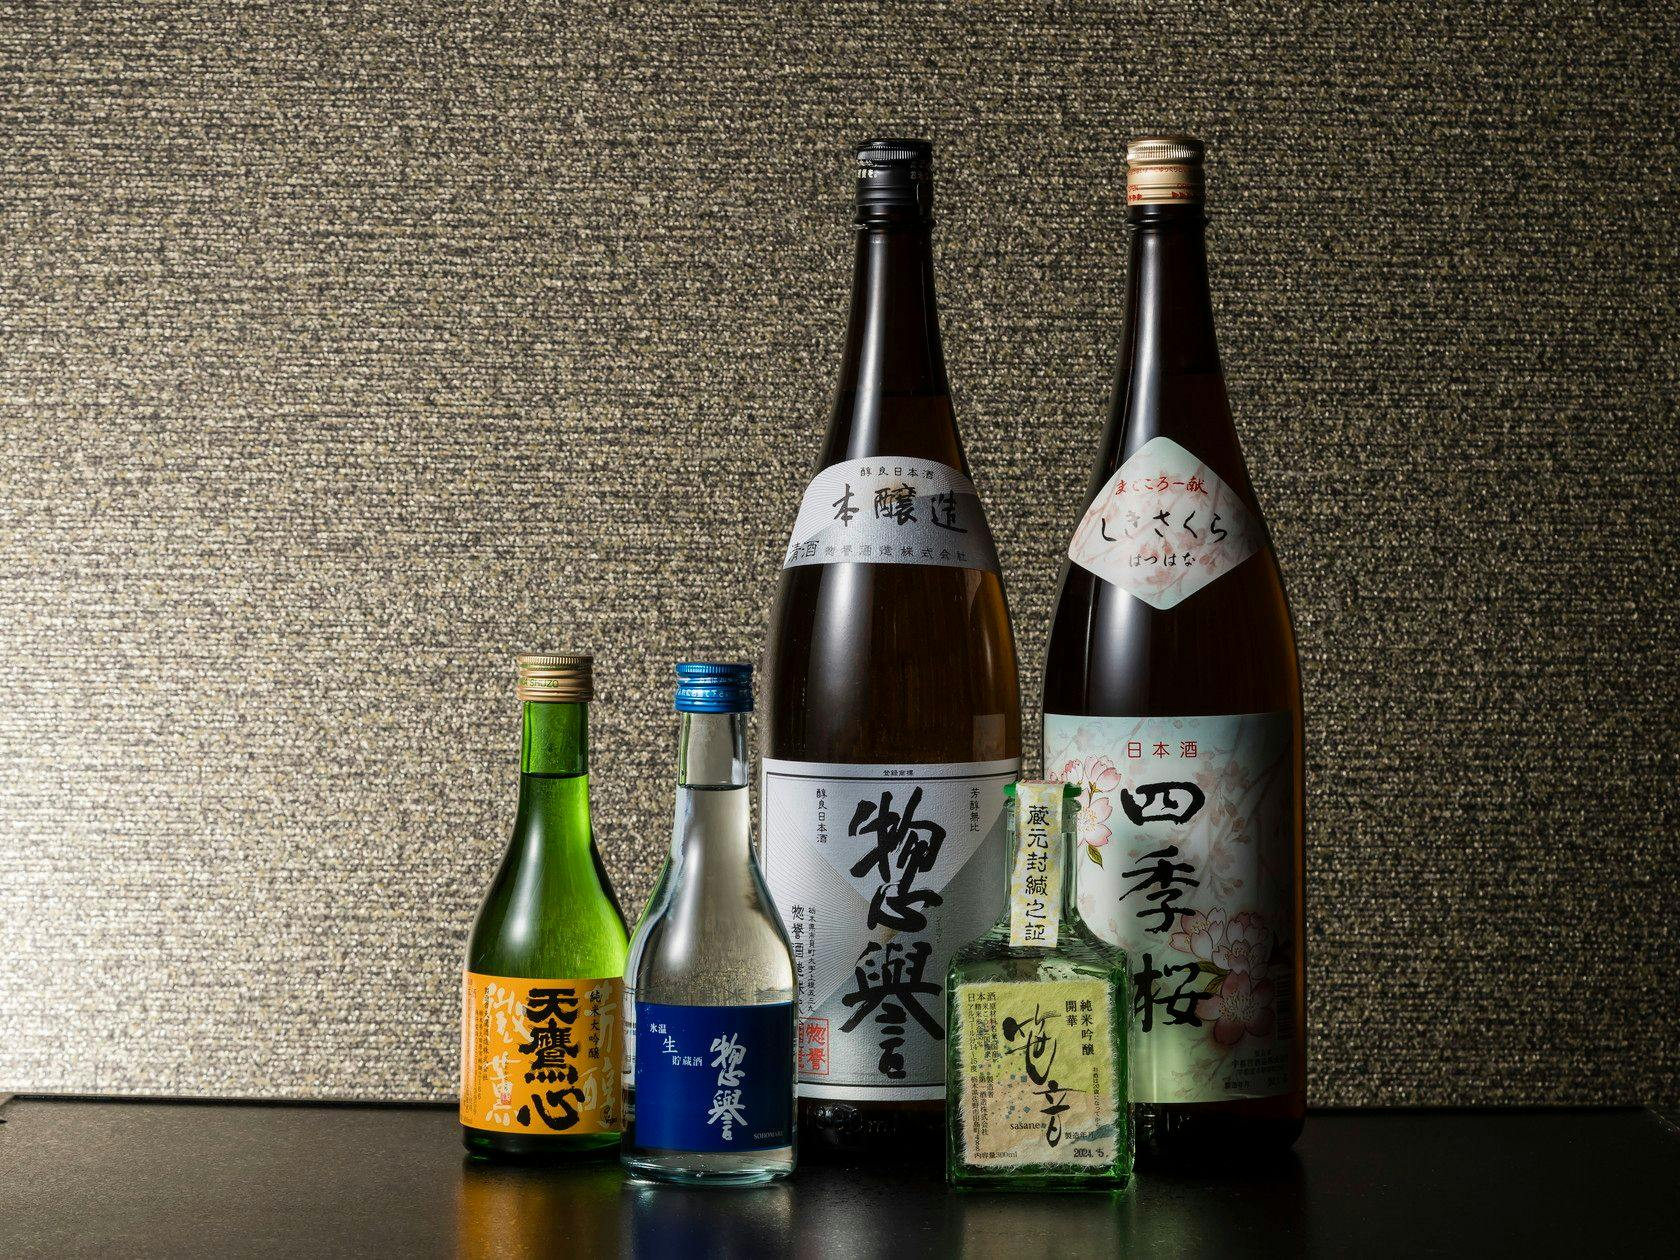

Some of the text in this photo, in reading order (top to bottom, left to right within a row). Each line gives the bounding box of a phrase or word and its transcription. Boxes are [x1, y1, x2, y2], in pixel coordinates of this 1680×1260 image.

[860, 466, 934, 480] 醇良日本酒
[832, 482, 968, 534] 本醸造
[1101, 509, 1229, 544] しきさくら
[1129, 552, 1197, 567] はつはな
[1127, 740, 1199, 759] 日本酒
[816, 788, 828, 844] 醇良日本酒
[969, 787, 980, 833] 芳醇無比
[1118, 780, 1213, 1034] 四季桜
[967, 991, 998, 1003] 日本酒
[588, 990, 602, 1060] 純米大吟醸
[1065, 1000, 1079, 1027] 開華
[649, 1022, 667, 1034] 氷温
[1079, 999, 1095, 1056] 純米吟醸
[661, 1035, 679, 1054] 生
[516, 987, 586, 1131] 天鷹心
[672, 1055, 704, 1067] 貯蔵酒
[1009, 1121, 1041, 1131] sasane
